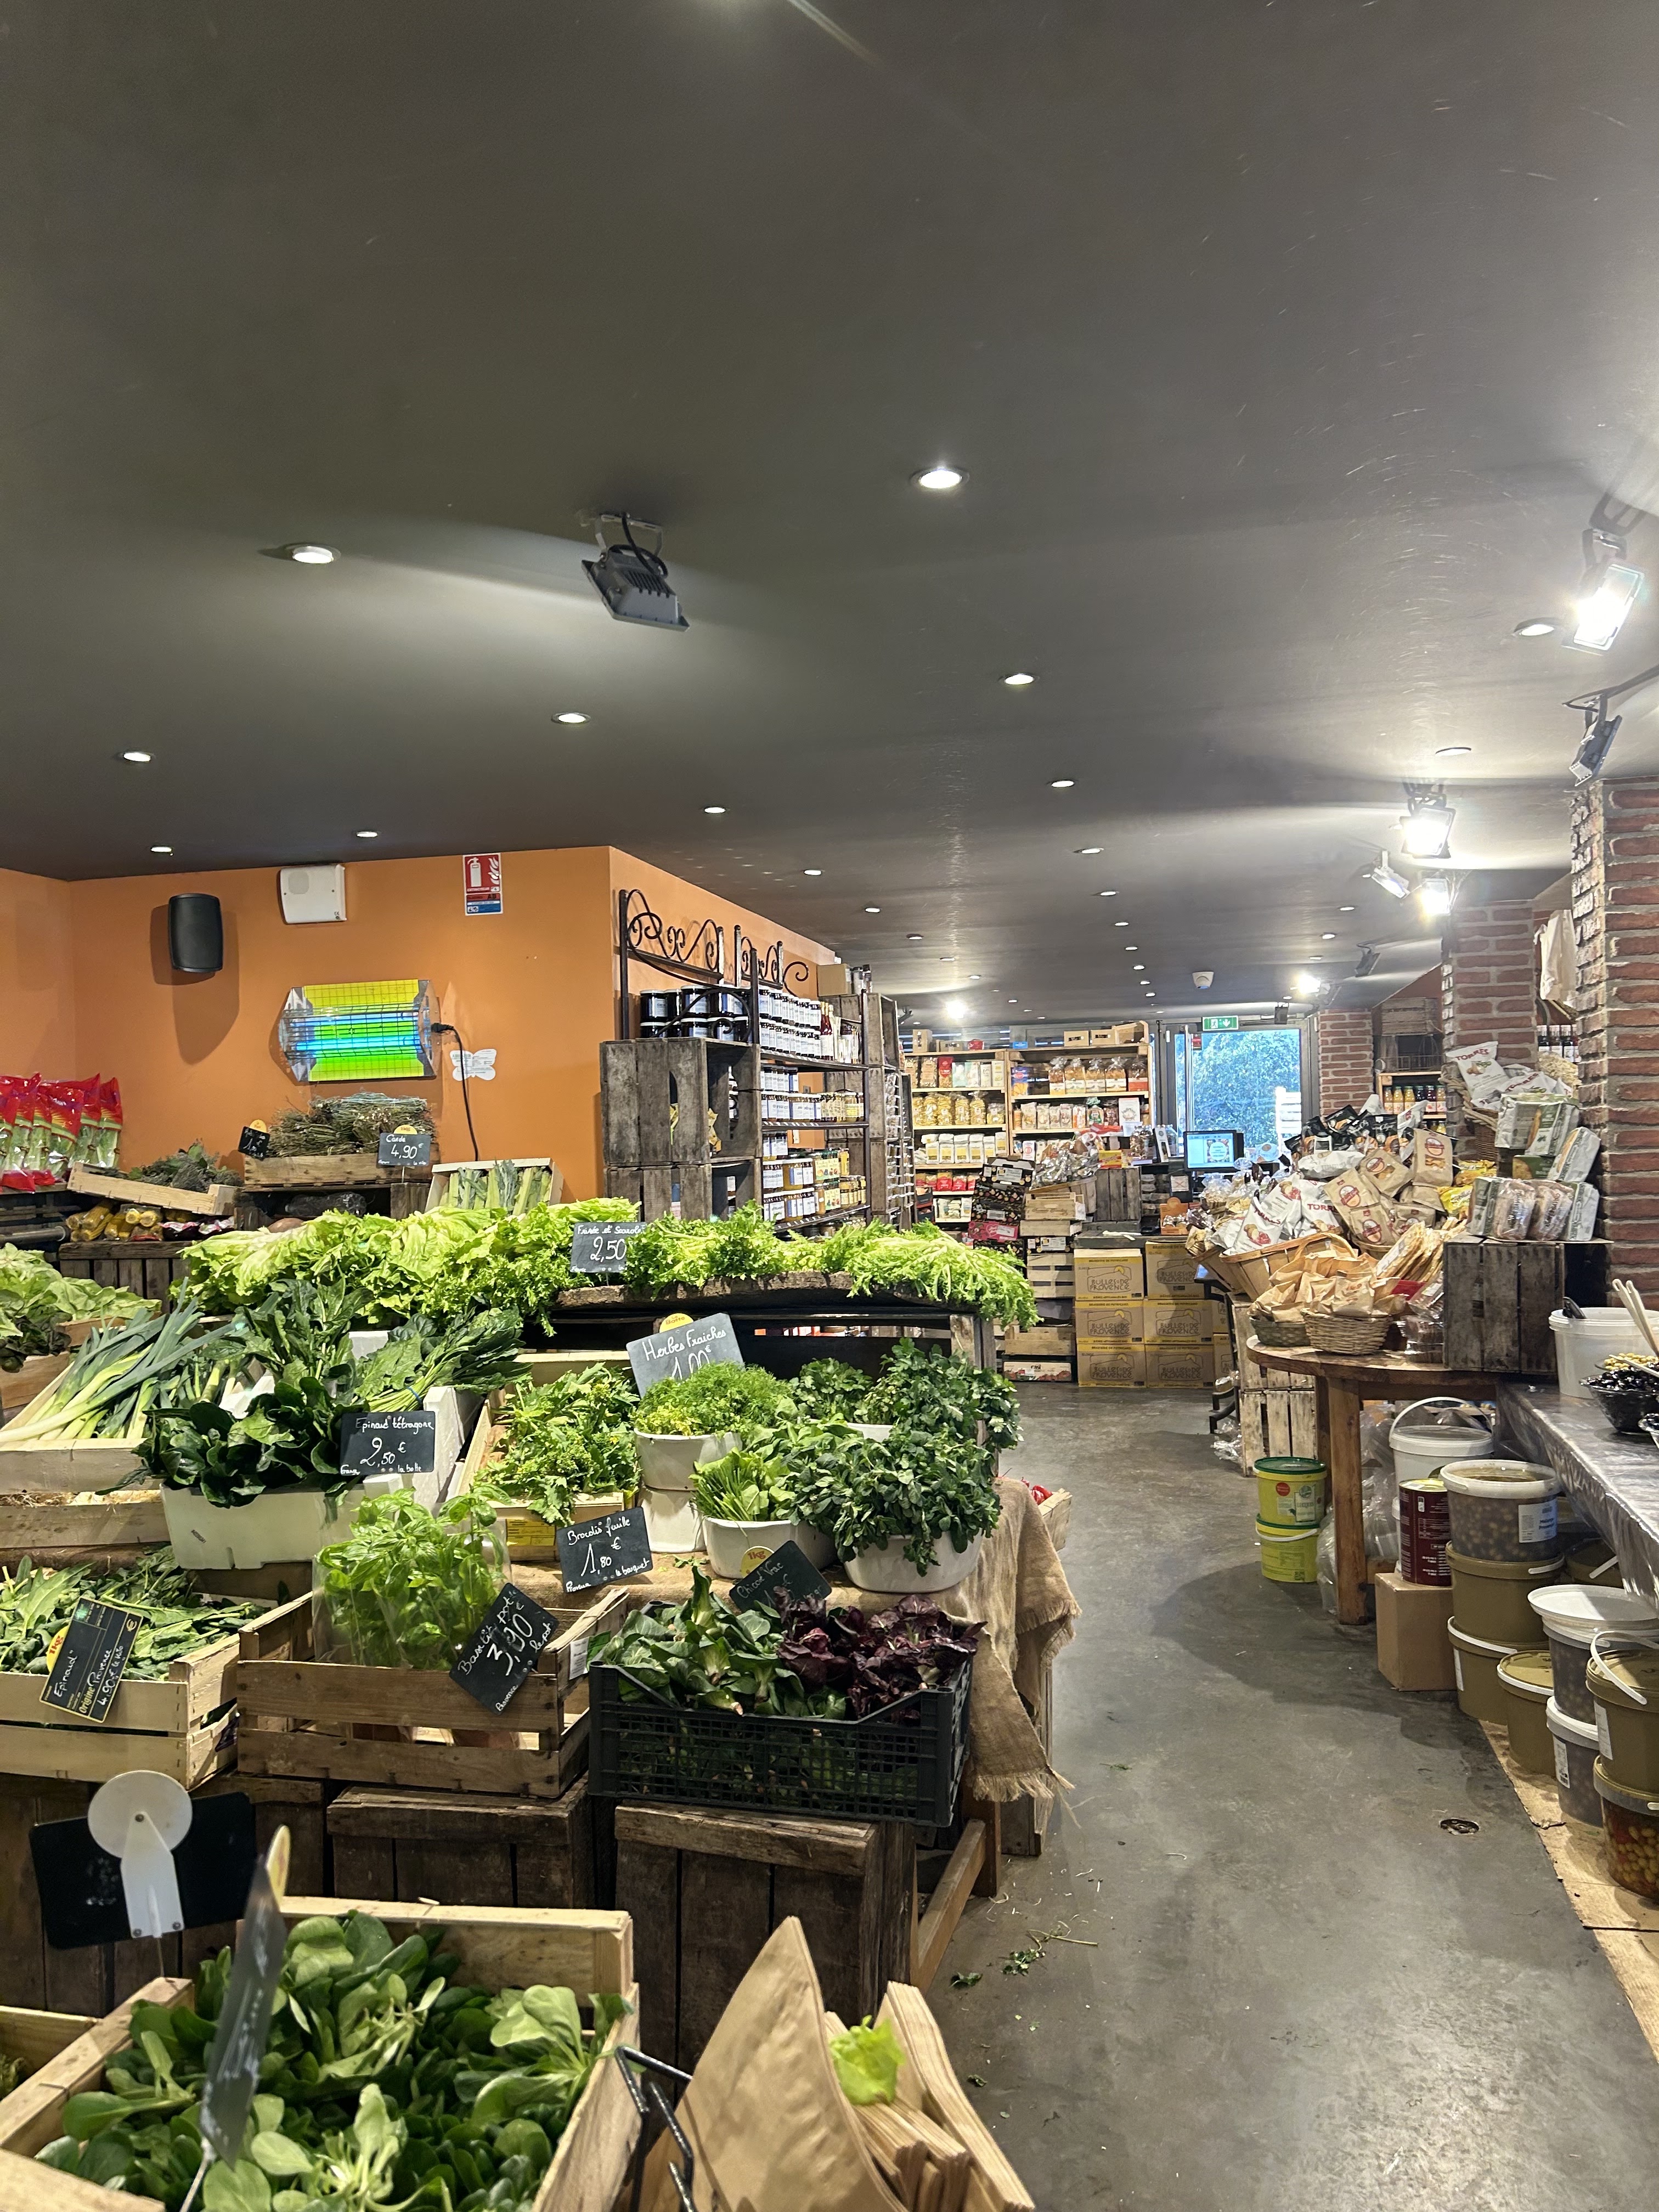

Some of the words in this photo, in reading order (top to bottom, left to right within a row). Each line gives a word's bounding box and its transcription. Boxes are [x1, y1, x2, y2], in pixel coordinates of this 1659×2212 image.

[1455, 1048, 1489, 1061] TORRES
[391, 1144, 417, 1159] 4,90
[1307, 1203, 1334, 1212] TORR
[590, 1236, 627, 1263] 2,50
[642, 1336, 685, 1361] Herbes
[686, 1326, 726, 1347] Fraiches
[355, 1417, 389, 1433] Epinaud
[360, 1437, 396, 1468] 2,50
[397, 1441, 407, 1453] €
[567, 1525, 602, 1546] Brocolis
[580, 1543, 612, 1577] 1,80
[611, 1536, 622, 1550] €
[747, 1551, 766, 1560] 1kg
[49, 1635, 64, 1655] 1kg
[487, 1613, 533, 1677] 3,90
[54, 1655, 77, 1697] Epinaud
[78, 1685, 95, 1713] Origine
